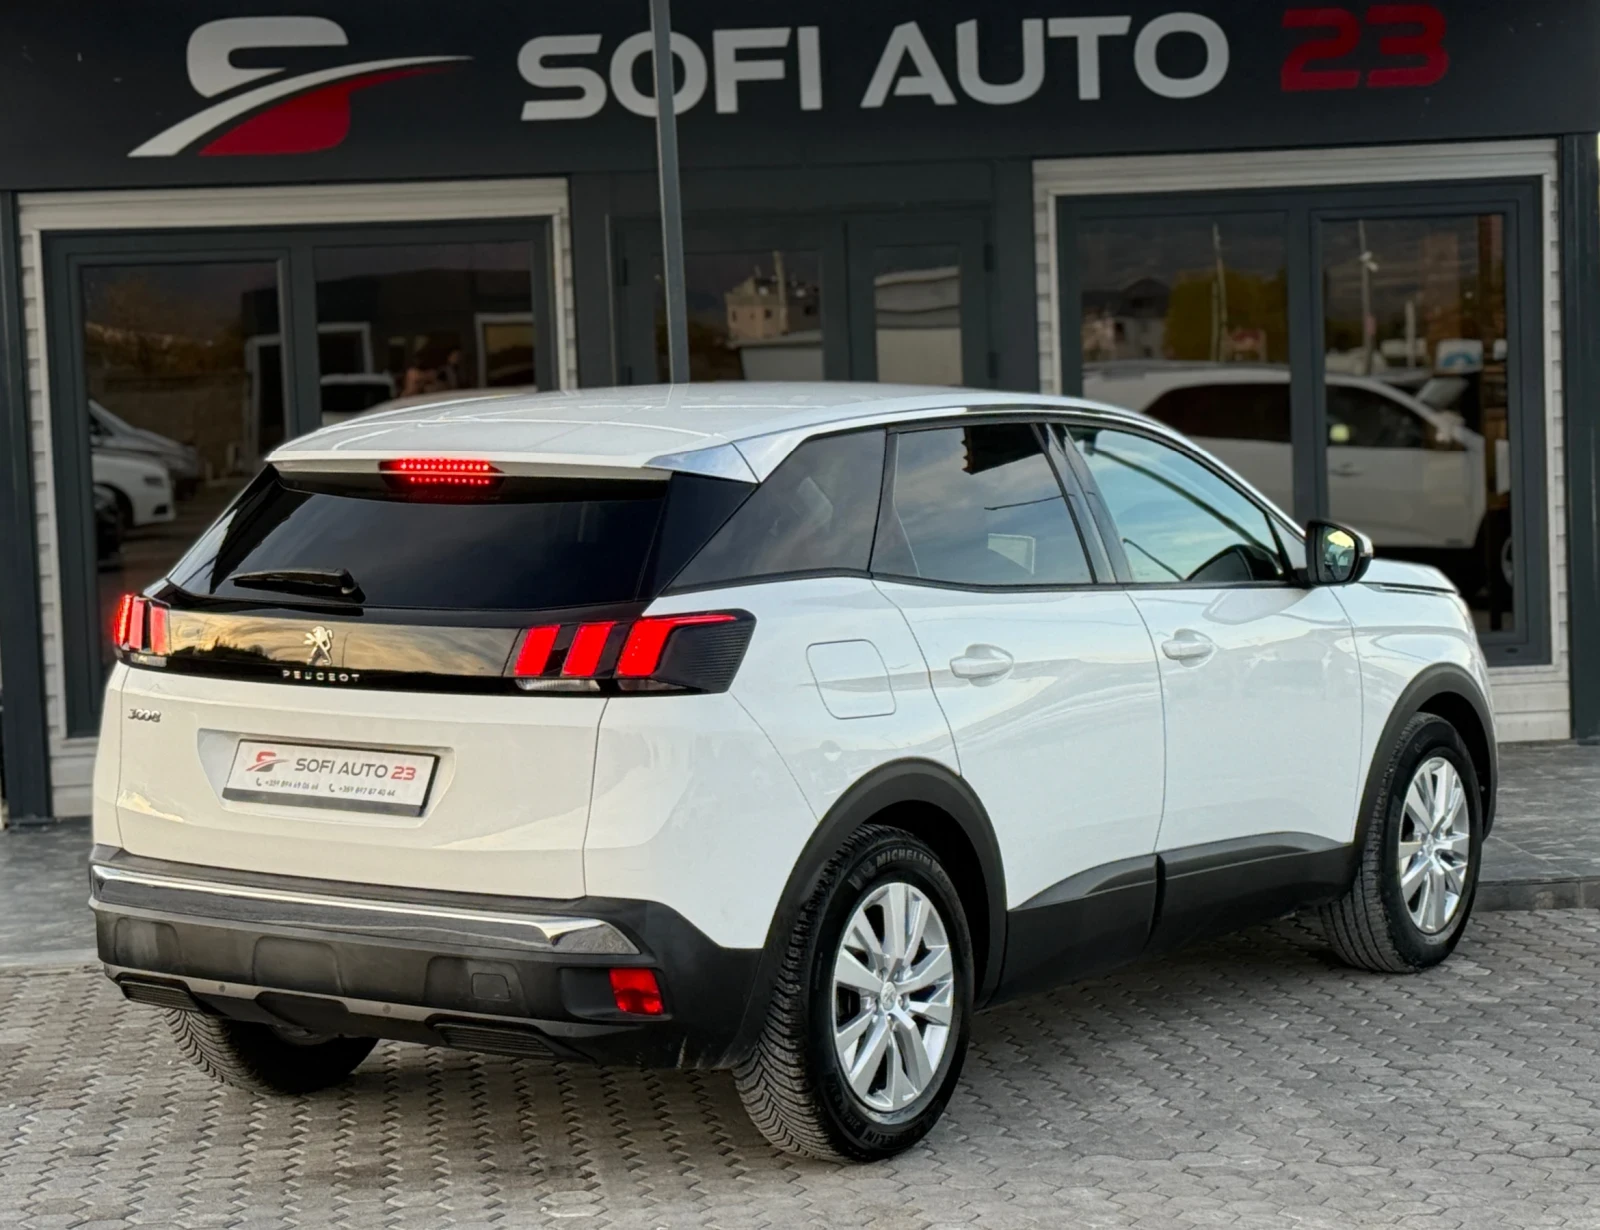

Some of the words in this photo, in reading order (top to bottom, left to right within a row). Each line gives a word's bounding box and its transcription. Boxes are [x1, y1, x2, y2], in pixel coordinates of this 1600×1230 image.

[517, 26, 822, 120] SOFI
[861, 12, 1229, 108] AUTO
[1280, 4, 1449, 91] 23
[282, 669, 360, 682] PEUGEOT
[127, 708, 162, 723] 3008
[294, 758, 335, 774] SOFI
[337, 761, 388, 778] AUTO
[391, 765, 417, 781] 23
[876, 849, 932, 868] MICHELIN
